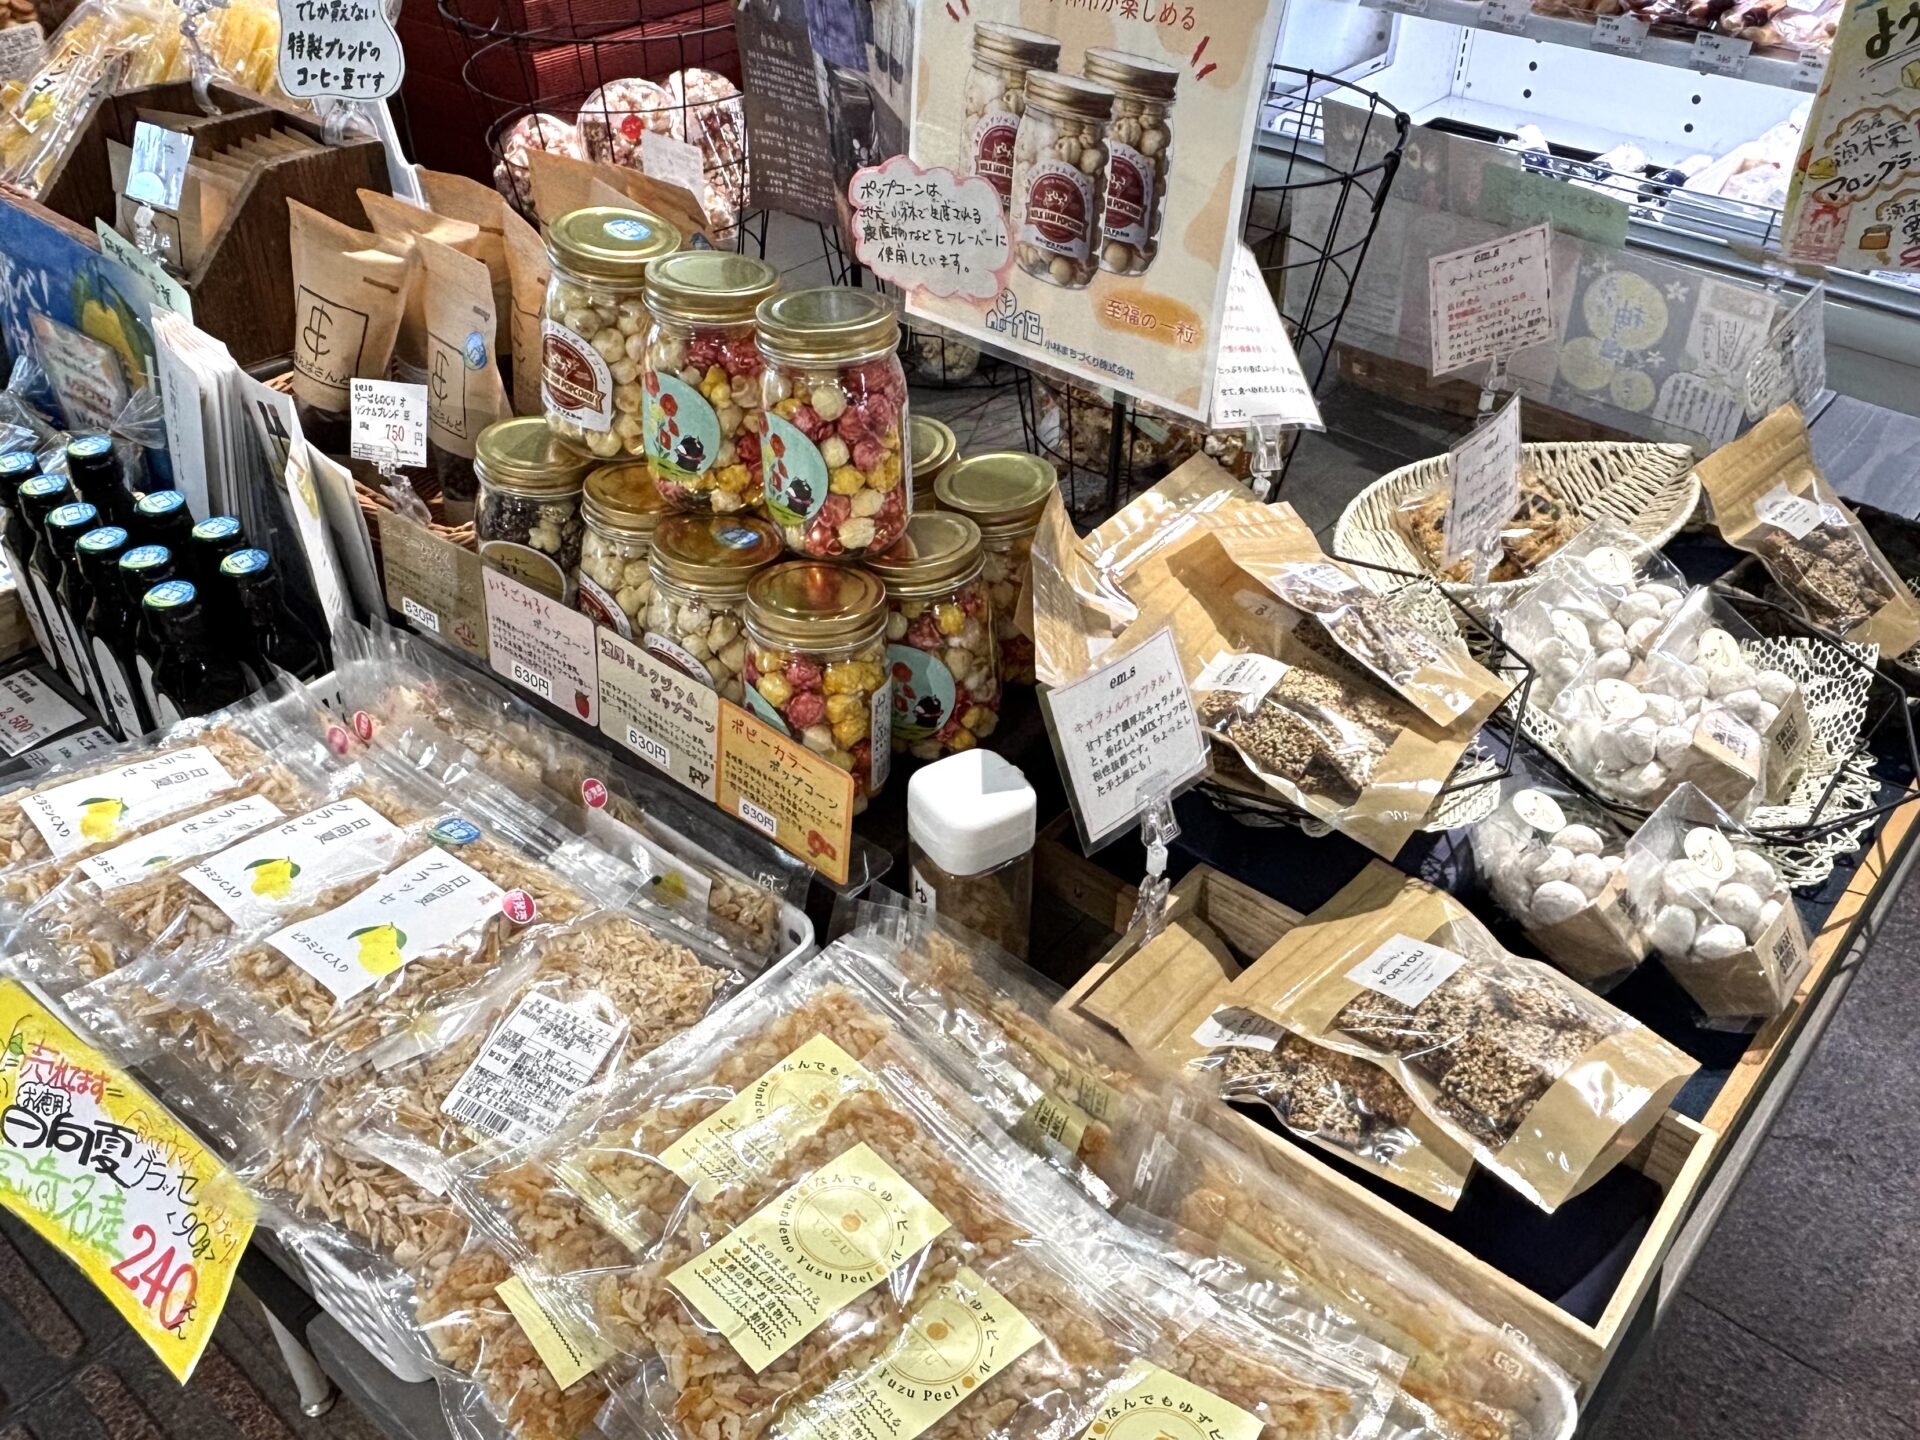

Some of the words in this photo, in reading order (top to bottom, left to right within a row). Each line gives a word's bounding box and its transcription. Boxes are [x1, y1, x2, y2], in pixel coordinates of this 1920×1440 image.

[287, 30, 381, 62] 特製ブレンドの
[860, 179, 942, 199] ポップコーンは
[877, 245, 970, 275] 使用しています。
[1105, 299, 1199, 345] 至福の一粒
[385, 424, 405, 442] 750
[488, 578, 551, 620] いちごみるく
[532, 618, 591, 656] ポップコーン
[513, 665, 549, 697] 630円
[1108, 666, 1137, 690] em.s
[650, 687, 716, 733] ポップコーン
[1073, 669, 1174, 735] キャラメルナッツタルト
[629, 729, 668, 765] 630円
[731, 718, 813, 774] ポピーカラー
[769, 759, 839, 810] ポップコーン
[280, 804, 354, 837] グラッセ
[313, 817, 372, 846] 日向夏
[741, 803, 775, 833] 630円
[378, 861, 449, 906] グラッセ
[413, 874, 472, 908] 日向夏
[290, 931, 350, 974] ビタミンC入り
[1378, 966, 1403, 987] FOR
[1402, 949, 1426, 972] YOU
[0, 1104, 139, 1189] 日向夏
[778, 1194, 798, 1254] nandemo
[796, 1255, 833, 1281] Yuzu
[840, 1272, 874, 1284] Peel
[111, 1224, 199, 1330] 240
[756, 1242, 822, 1306] そのまま食べれる
[923, 1386, 960, 1402] Peel
